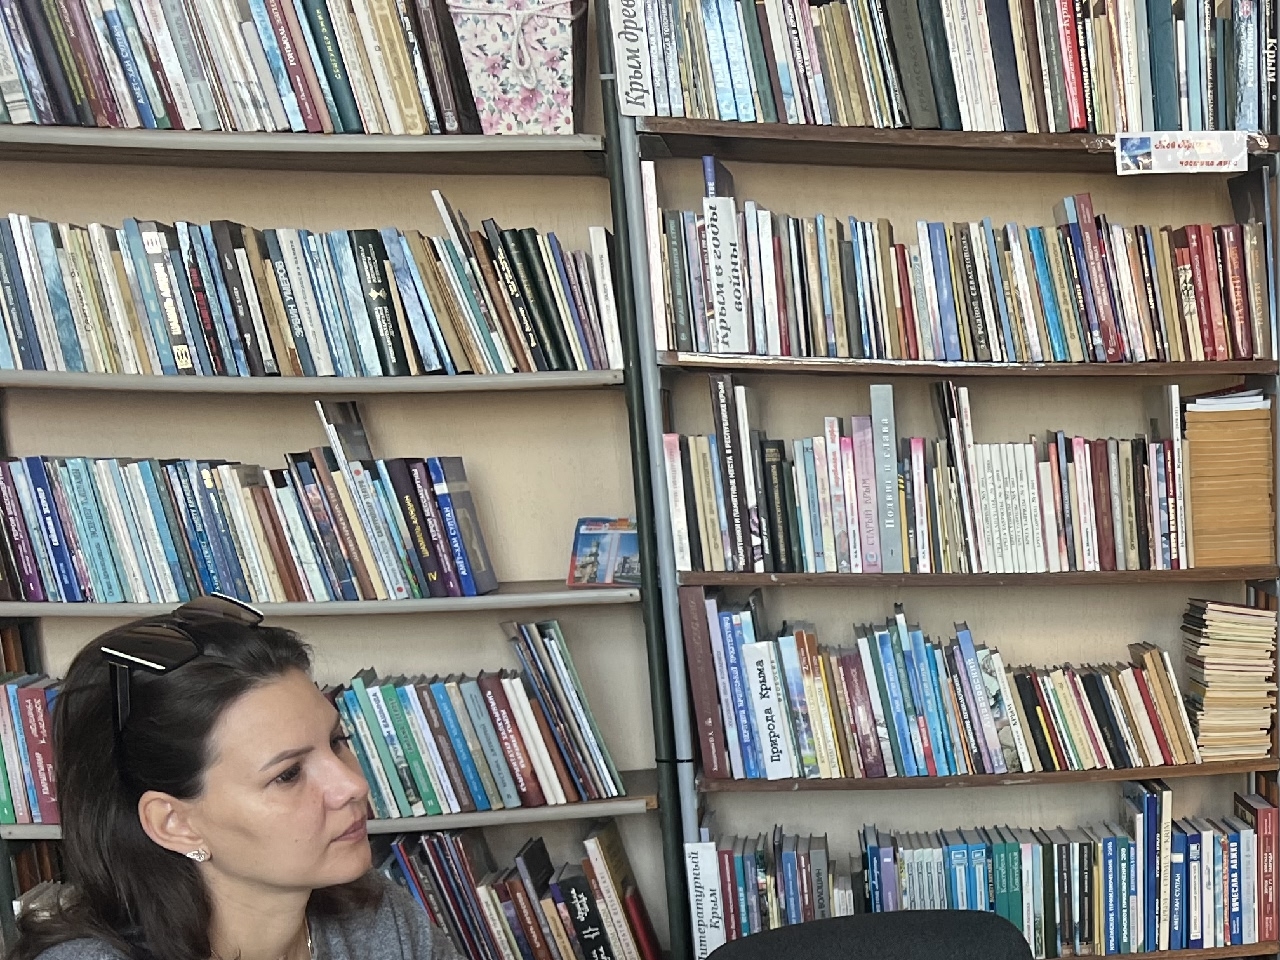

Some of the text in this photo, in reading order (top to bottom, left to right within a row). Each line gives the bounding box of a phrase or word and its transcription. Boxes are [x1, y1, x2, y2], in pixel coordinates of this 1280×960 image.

[624, 48, 651, 109] Крым
[1262, 37, 1278, 83] Крым
[706, 204, 732, 348] Крым в годы
[728, 241, 743, 312] войны
[274, 260, 304, 338] ЭРВИН УМЕРОВ
[717, 381, 727, 404] КРЫМ
[879, 417, 891, 458] слава
[727, 455, 735, 479] МЕСТА
[728, 478, 740, 518] ПАМЯТНЫЕ
[884, 478, 895, 528] Подвиг
[424, 518, 438, 540] ГЕРОИ
[443, 506, 458, 536] СУЛТАН
[734, 523, 746, 566] ПАМЯТНИКИ
[754, 659, 783, 763] Природа Крыма
[709, 888, 722, 929] Крым
[815, 868, 826, 910] ВОЛОШИН
[1230, 872, 1240, 913] ВЯЧЕСЛАВ
